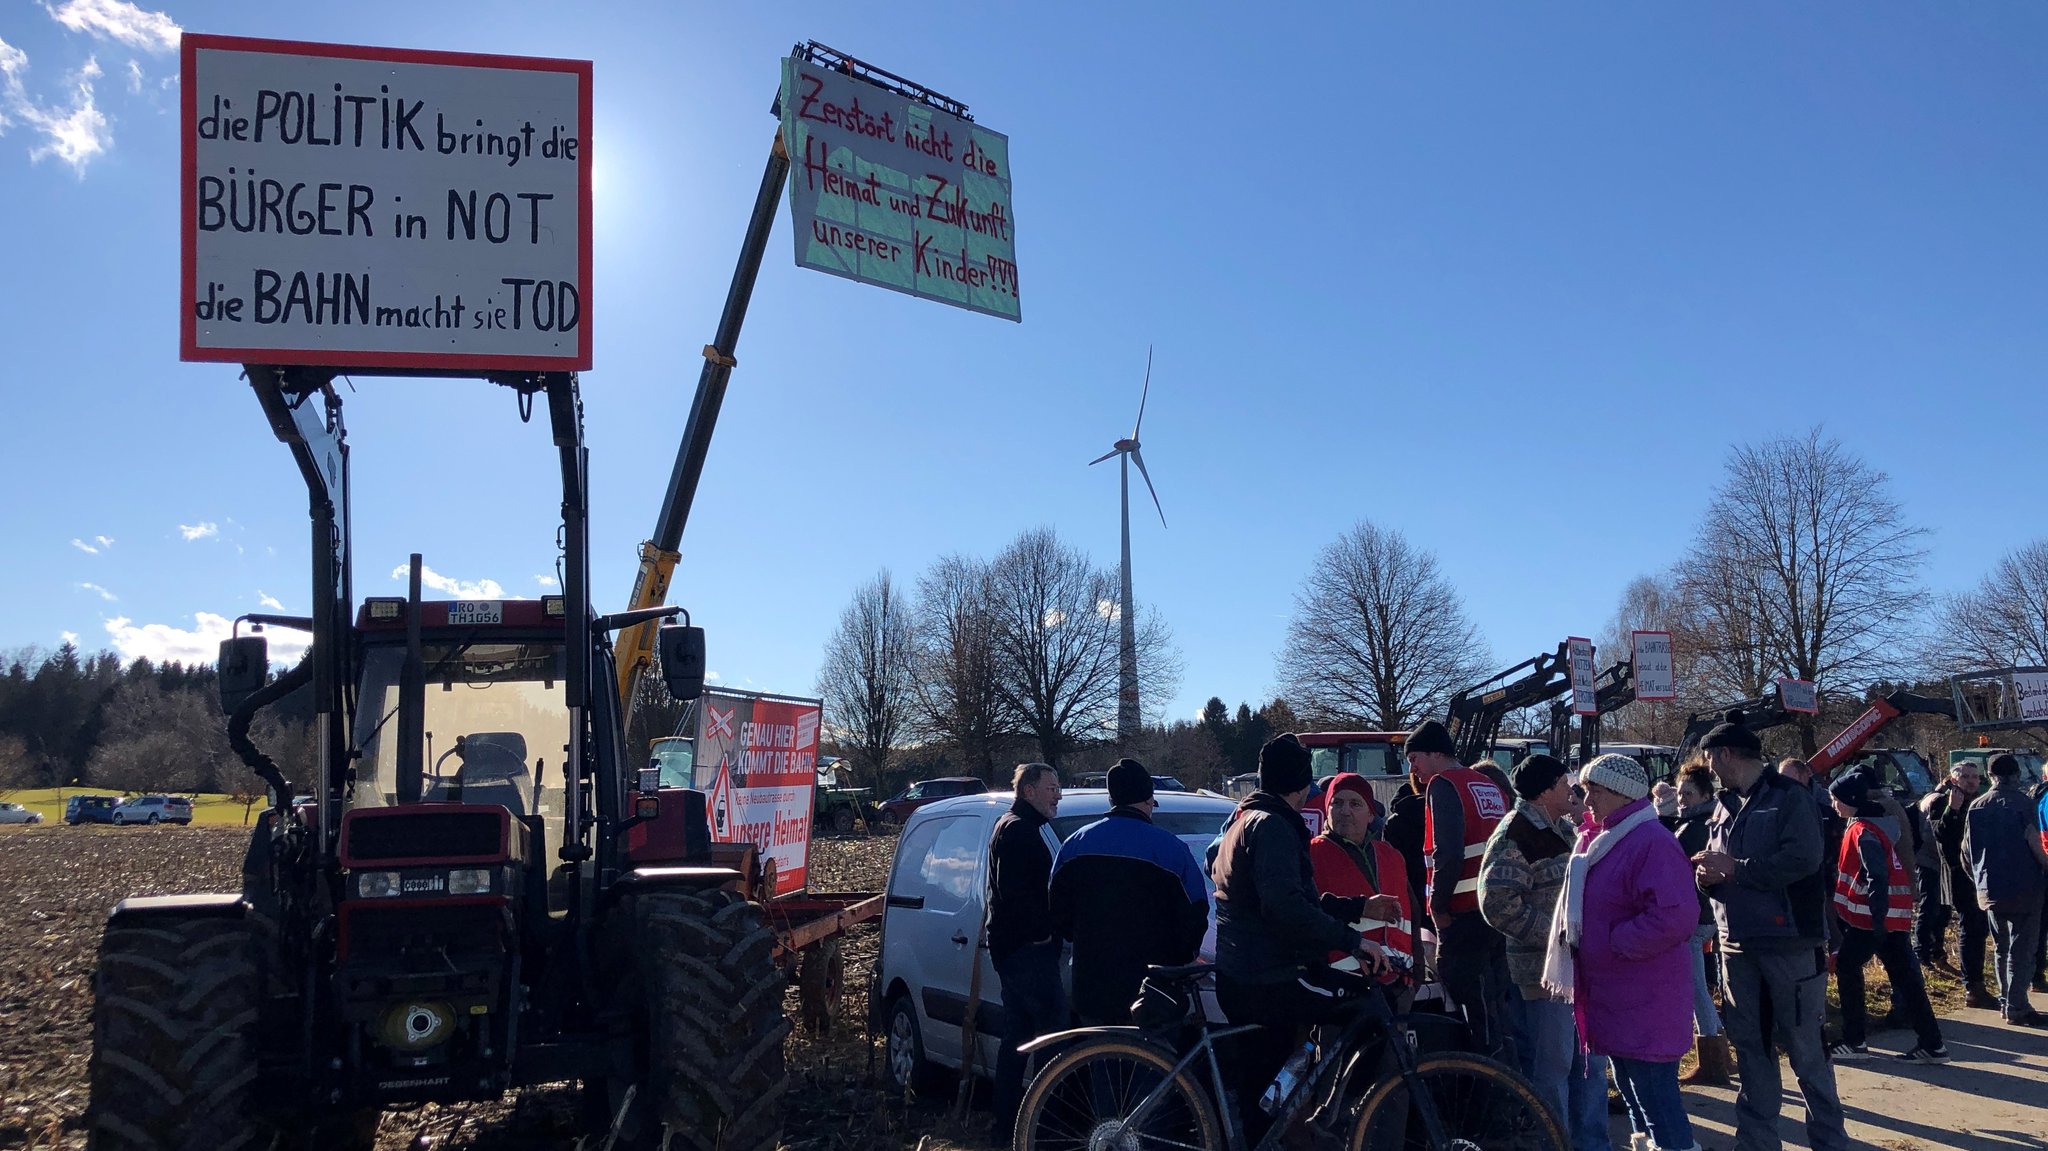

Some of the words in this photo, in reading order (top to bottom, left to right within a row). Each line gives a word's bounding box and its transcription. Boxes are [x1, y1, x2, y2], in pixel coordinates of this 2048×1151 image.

[199, 95, 249, 141] die
[438, 113, 535, 167] bringt
[543, 126, 579, 161] die
[799, 72, 895, 143] Zerstört
[905, 124, 953, 163] nicht
[963, 139, 997, 177] die
[199, 167, 374, 237] BÜRGER
[395, 196, 427, 239] in
[447, 189, 554, 244] NOT
[804, 135, 881, 207] Heimat
[890, 194, 921, 219] und
[813, 219, 901, 263] unserer
[913, 230, 1018, 298] Kinder!!!
[195, 282, 243, 323] die
[253, 269, 370, 325] BAHN
[376, 294, 465, 328] macht
[474, 297, 507, 330] sie
[501, 277, 580, 332] TOD
[458, 602, 475, 613] RO
[737, 750, 774, 774] KOMMT
[774, 751, 789, 774] DIE
[740, 722, 774, 747] GENAU
[774, 724, 795, 748] HIER
[733, 821, 771, 849] unsere
[773, 809, 808, 847] Heimat
